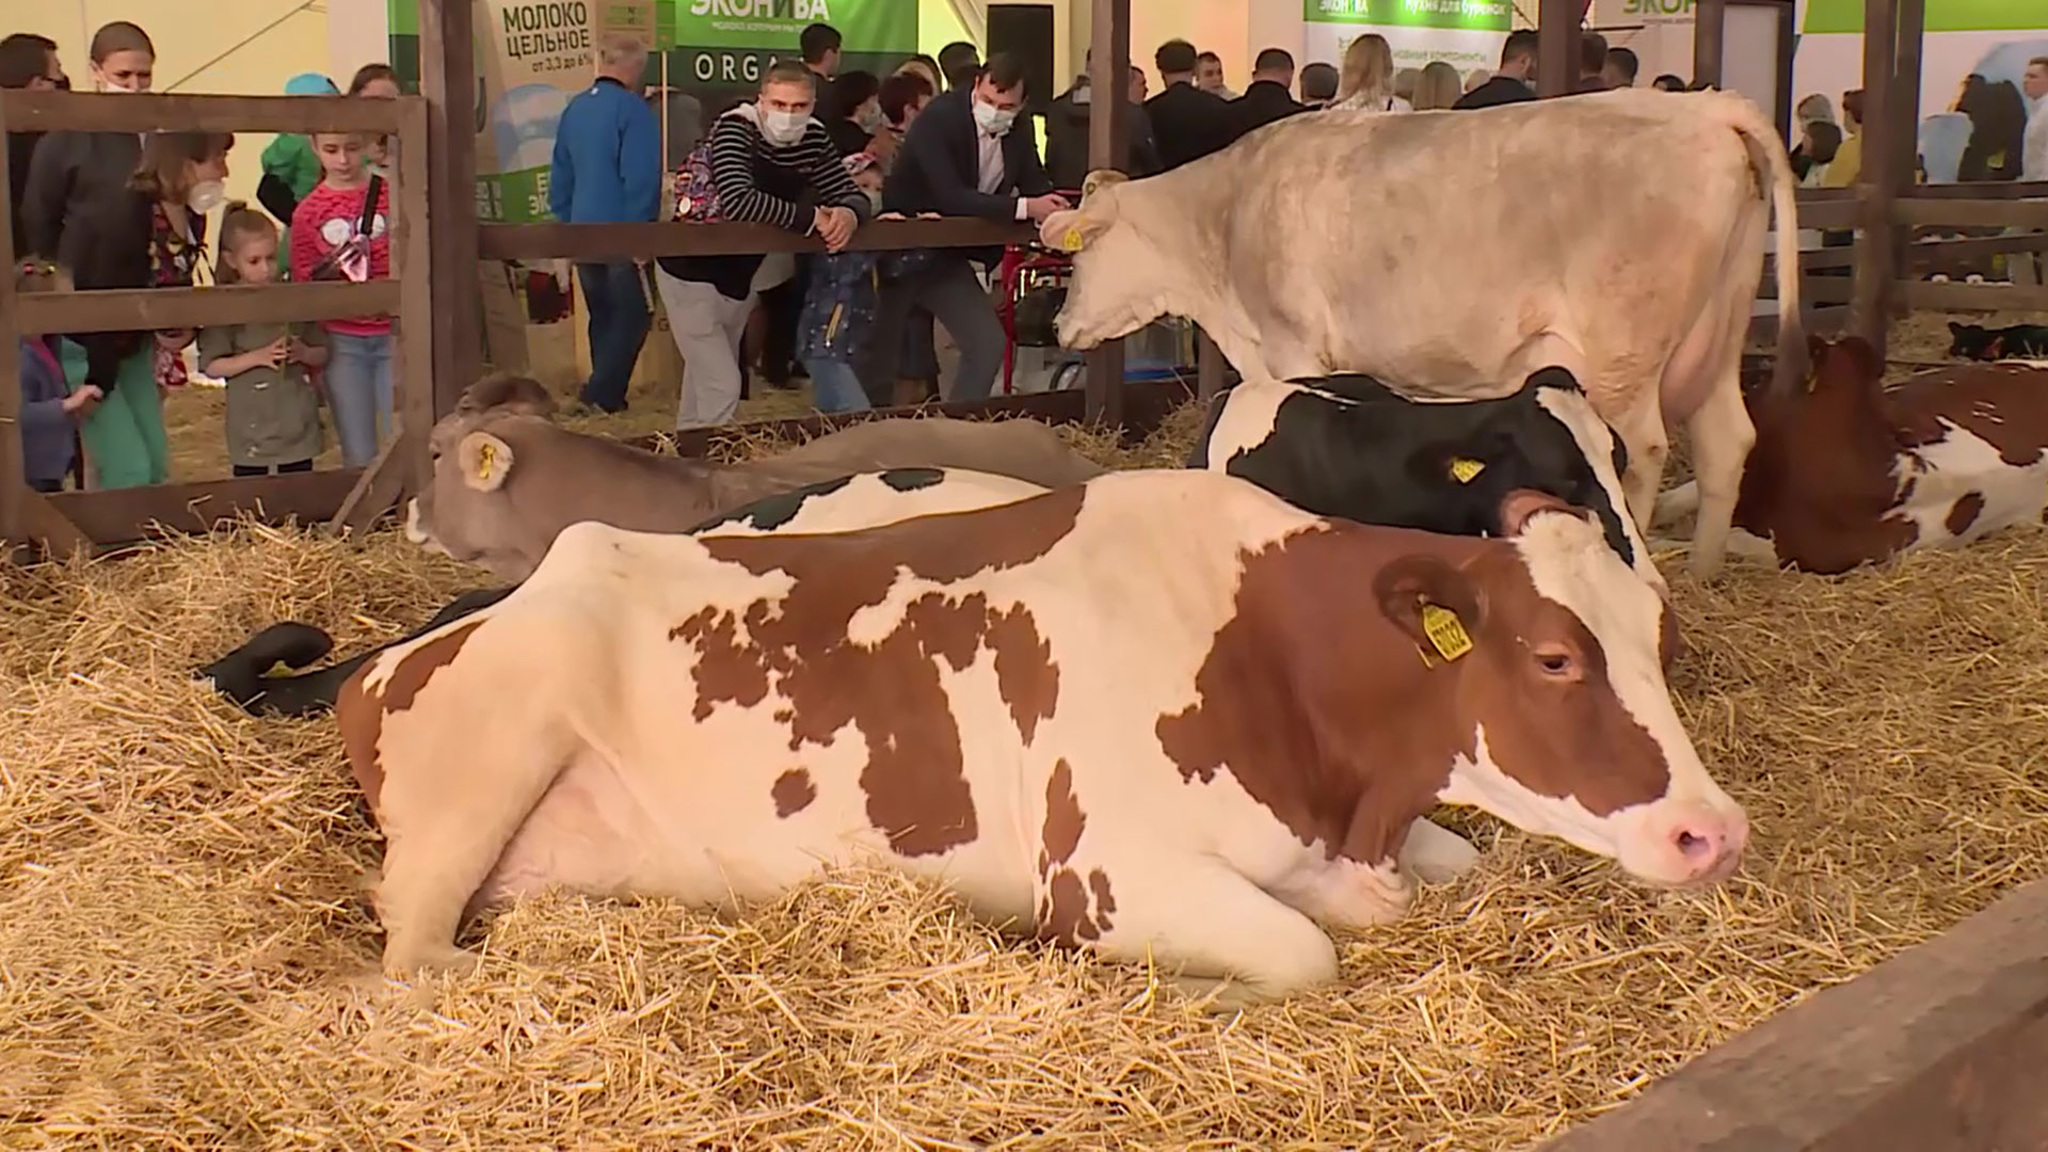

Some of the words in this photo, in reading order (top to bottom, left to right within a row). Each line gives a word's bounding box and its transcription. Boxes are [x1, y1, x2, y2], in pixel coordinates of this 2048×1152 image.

[503, 1, 587, 33] МОЛОКО
[506, 28, 591, 60] ЦЕЛЬНОЕ
[532, 61, 543, 72] от
[564, 58, 576, 69] до
